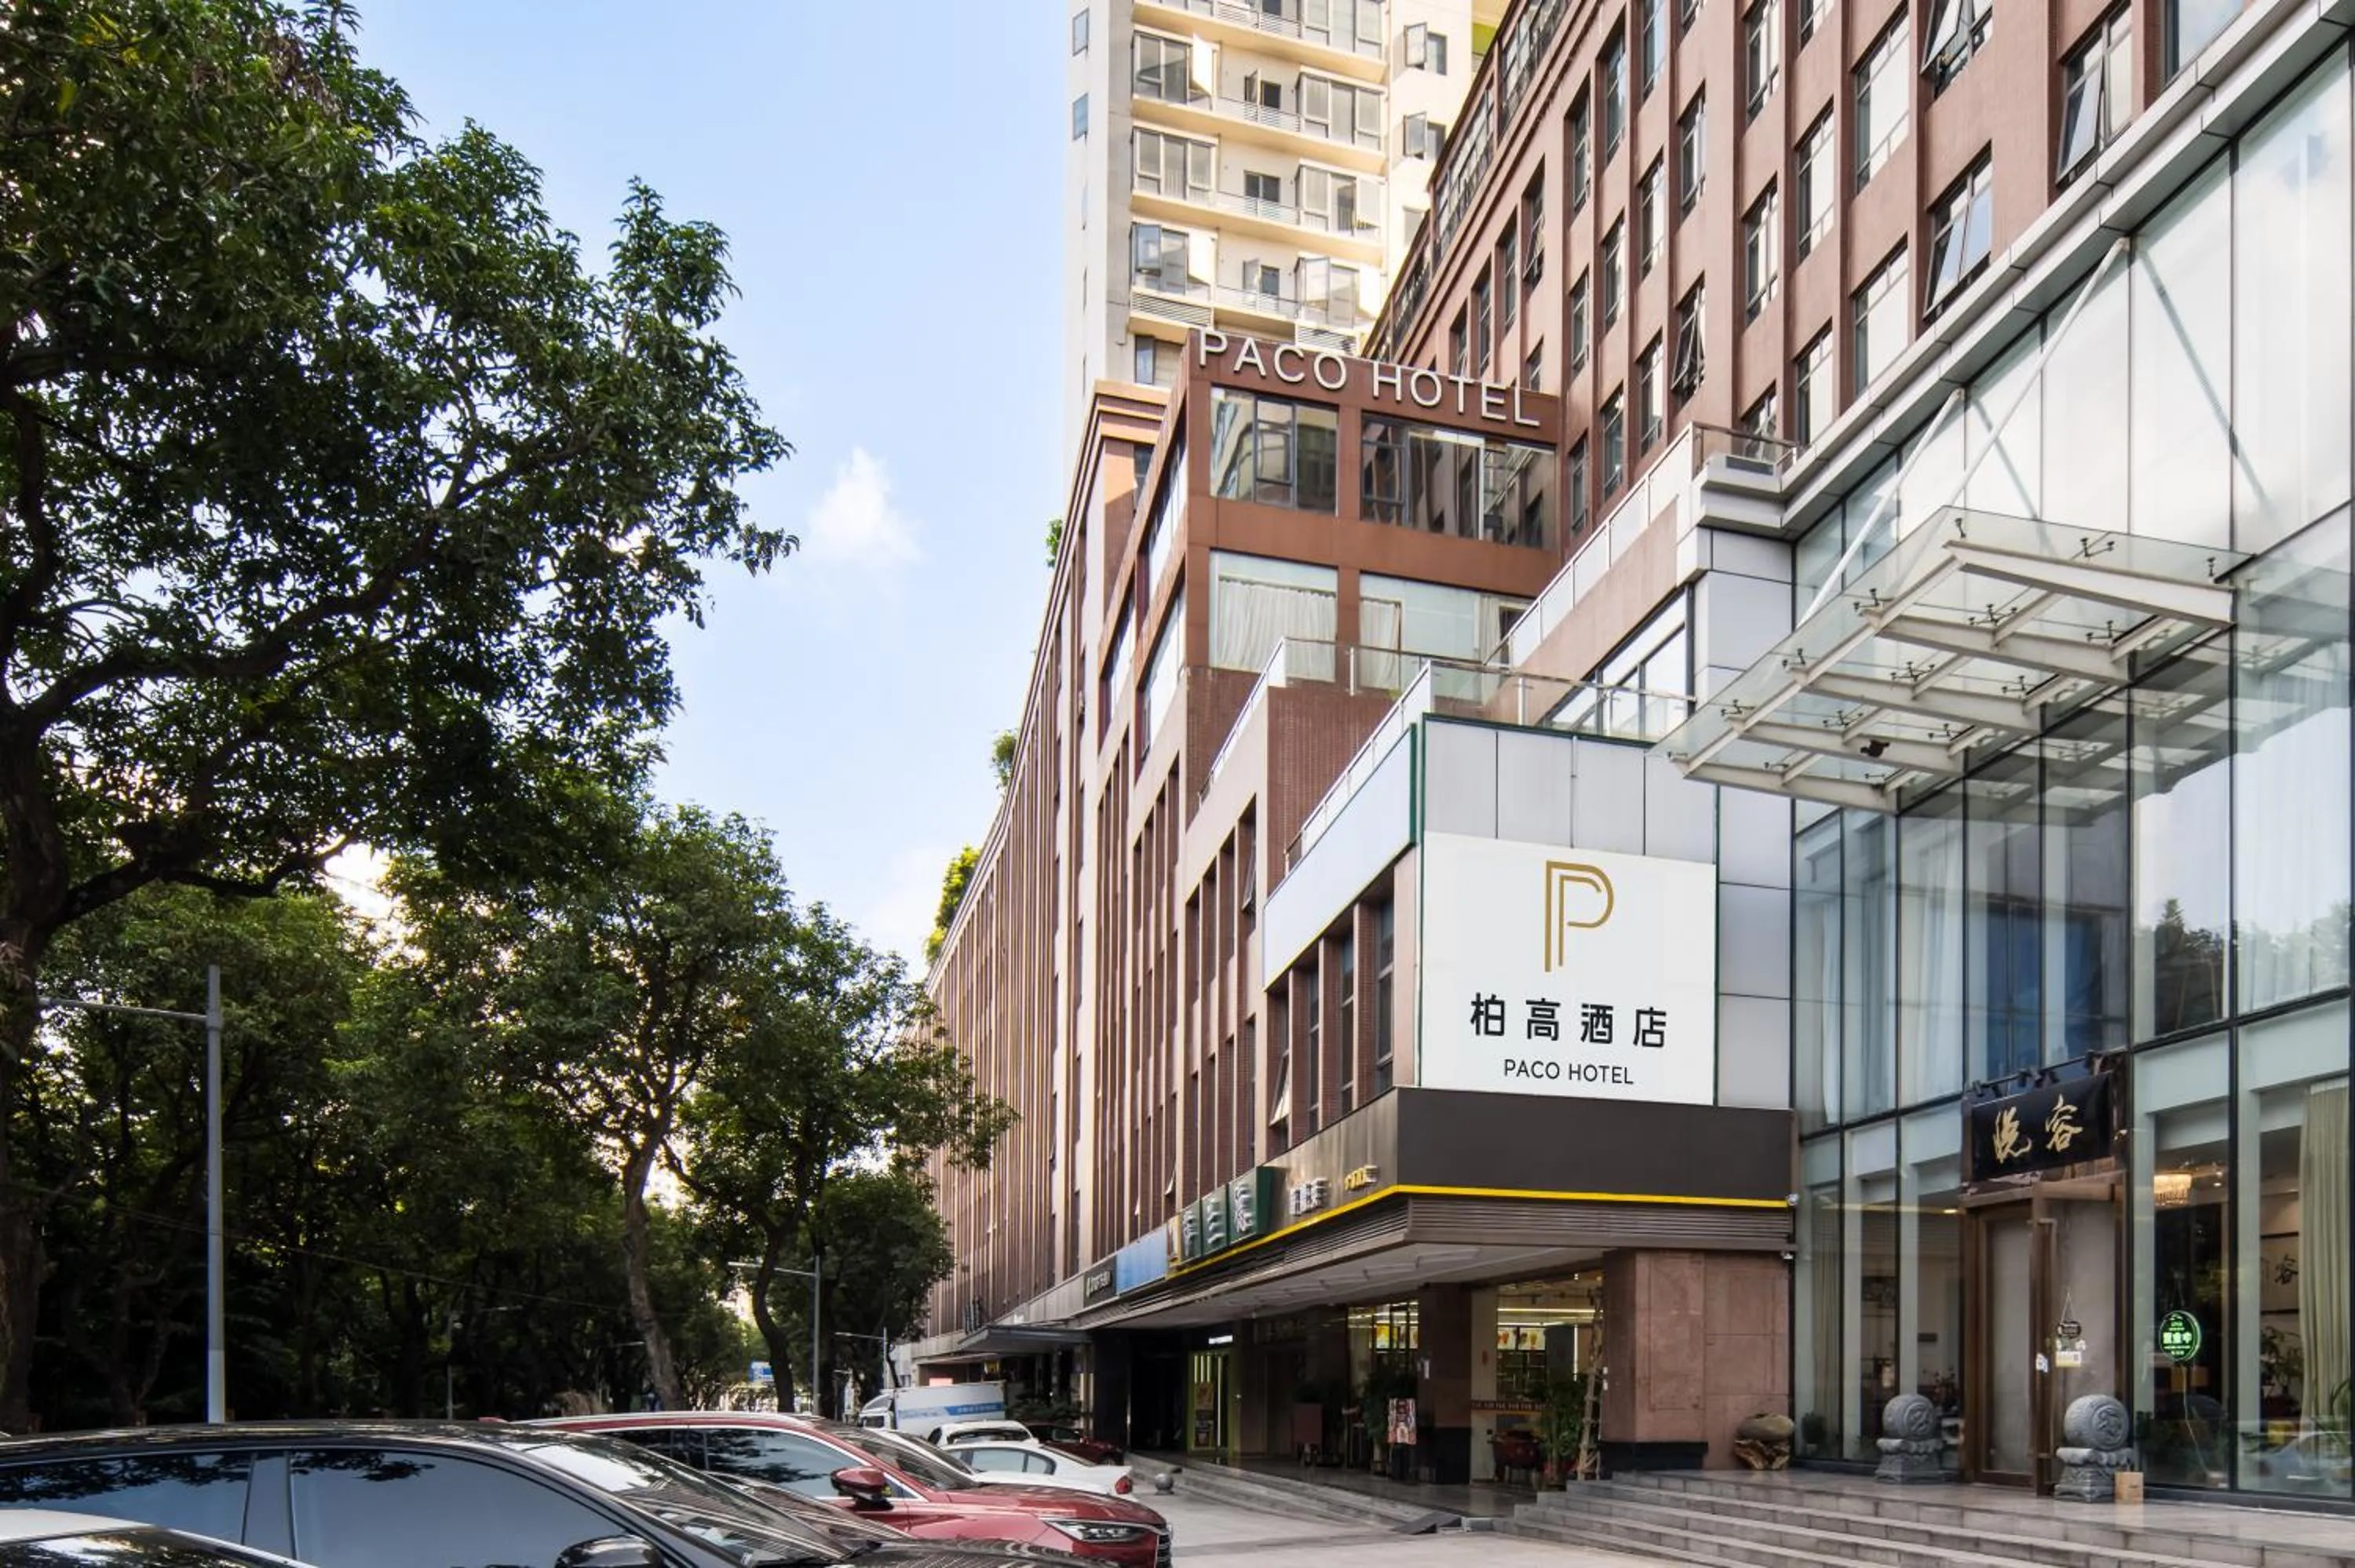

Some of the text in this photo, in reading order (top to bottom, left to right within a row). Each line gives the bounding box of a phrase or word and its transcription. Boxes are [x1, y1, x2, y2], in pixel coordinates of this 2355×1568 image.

[1197, 327, 1541, 428] PACO HOTEL
[1470, 992, 1667, 1048] 柏高酒店
[1504, 1059, 1634, 1085] PACO HOTEL
